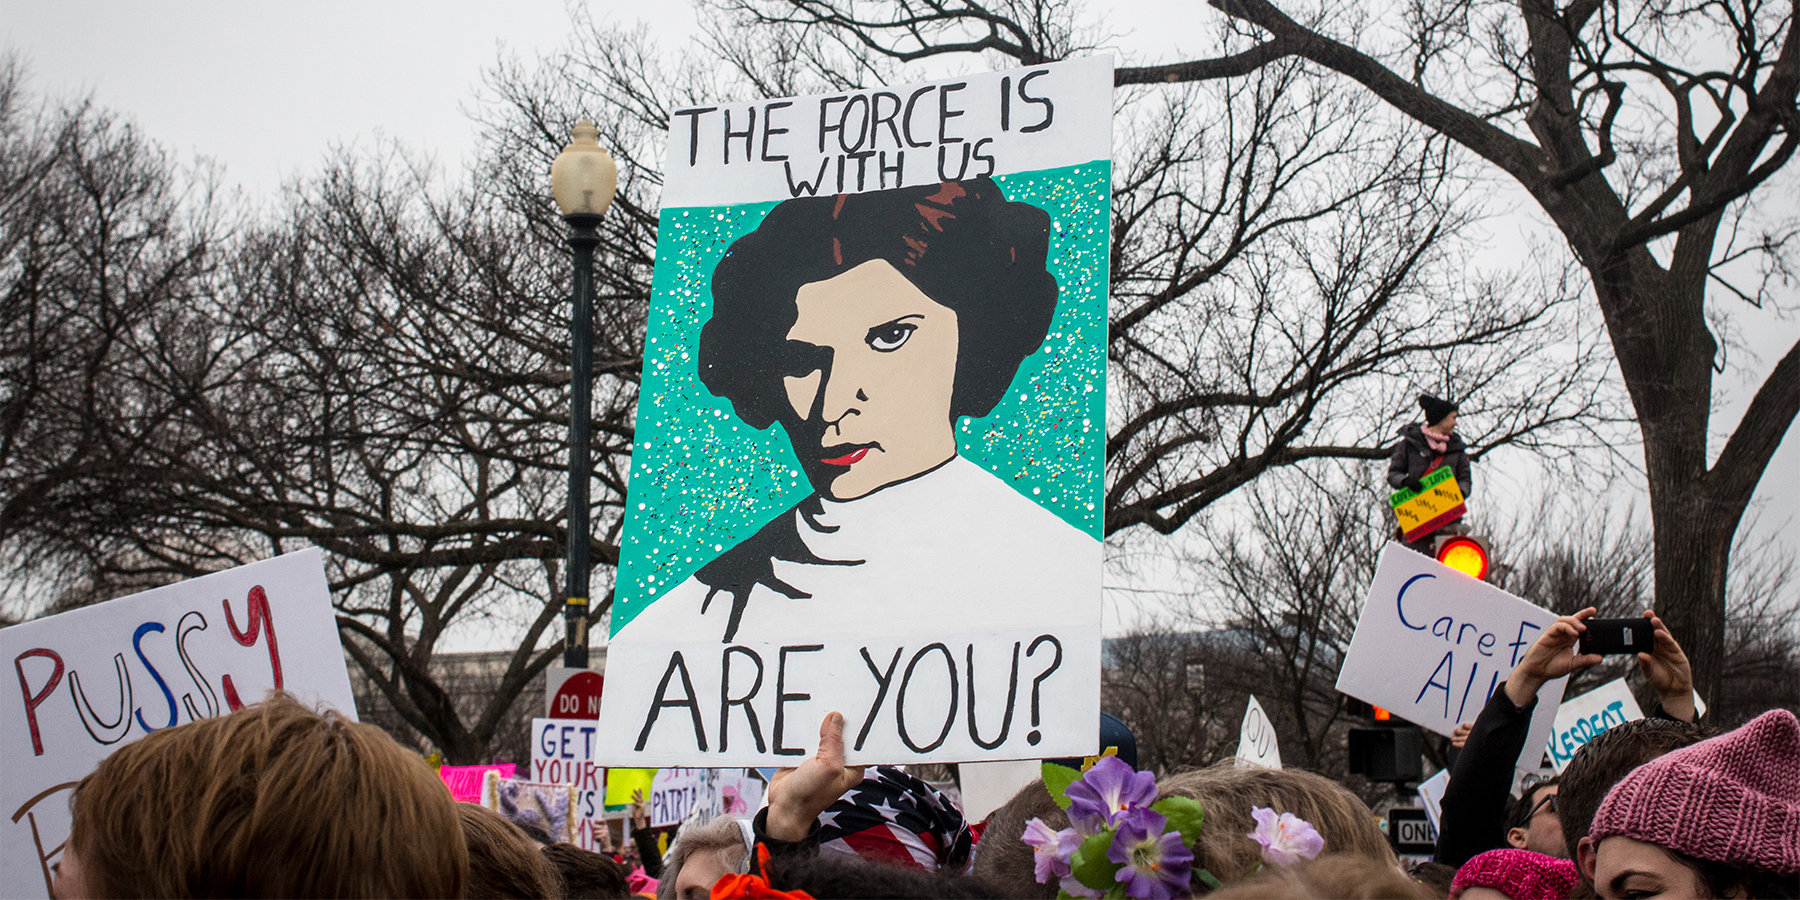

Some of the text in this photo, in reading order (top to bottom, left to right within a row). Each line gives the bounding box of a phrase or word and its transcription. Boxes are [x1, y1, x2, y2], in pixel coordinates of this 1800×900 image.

[674, 69, 1054, 166] THE FORCE IS
[784, 137, 994, 197] WITH US
[1397, 573, 1496, 656] Care
[14, 585, 283, 756] PUSSY
[560, 694, 580, 713] DO
[633, 633, 1063, 755] ARE YOU?
[535, 759, 597, 791] YOUR
[541, 723, 596, 760] GET
